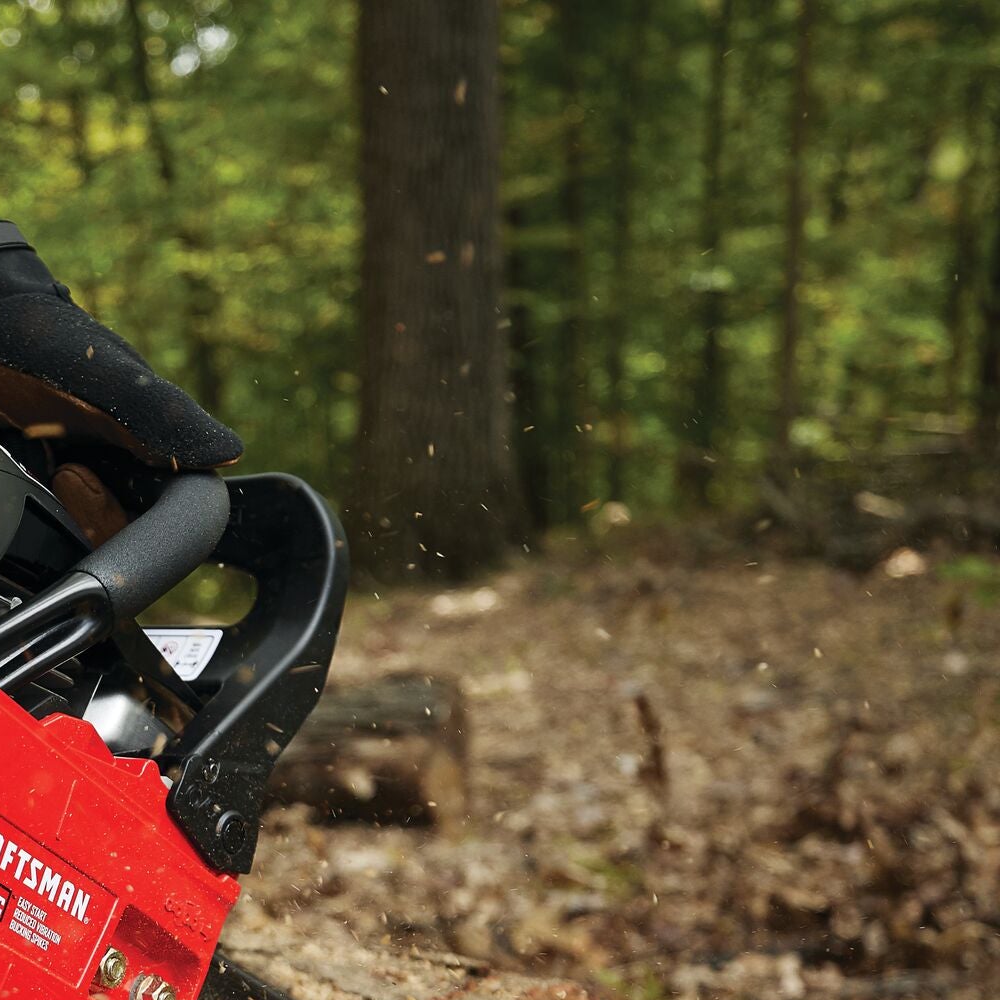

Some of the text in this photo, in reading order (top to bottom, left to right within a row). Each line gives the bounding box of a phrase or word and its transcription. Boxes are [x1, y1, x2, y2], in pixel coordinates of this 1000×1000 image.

[17, 896, 48, 922] EASY START
[9, 919, 50, 951] BUCKING SPIKES
[13, 908, 62, 945] REDUCED VIBRATION
